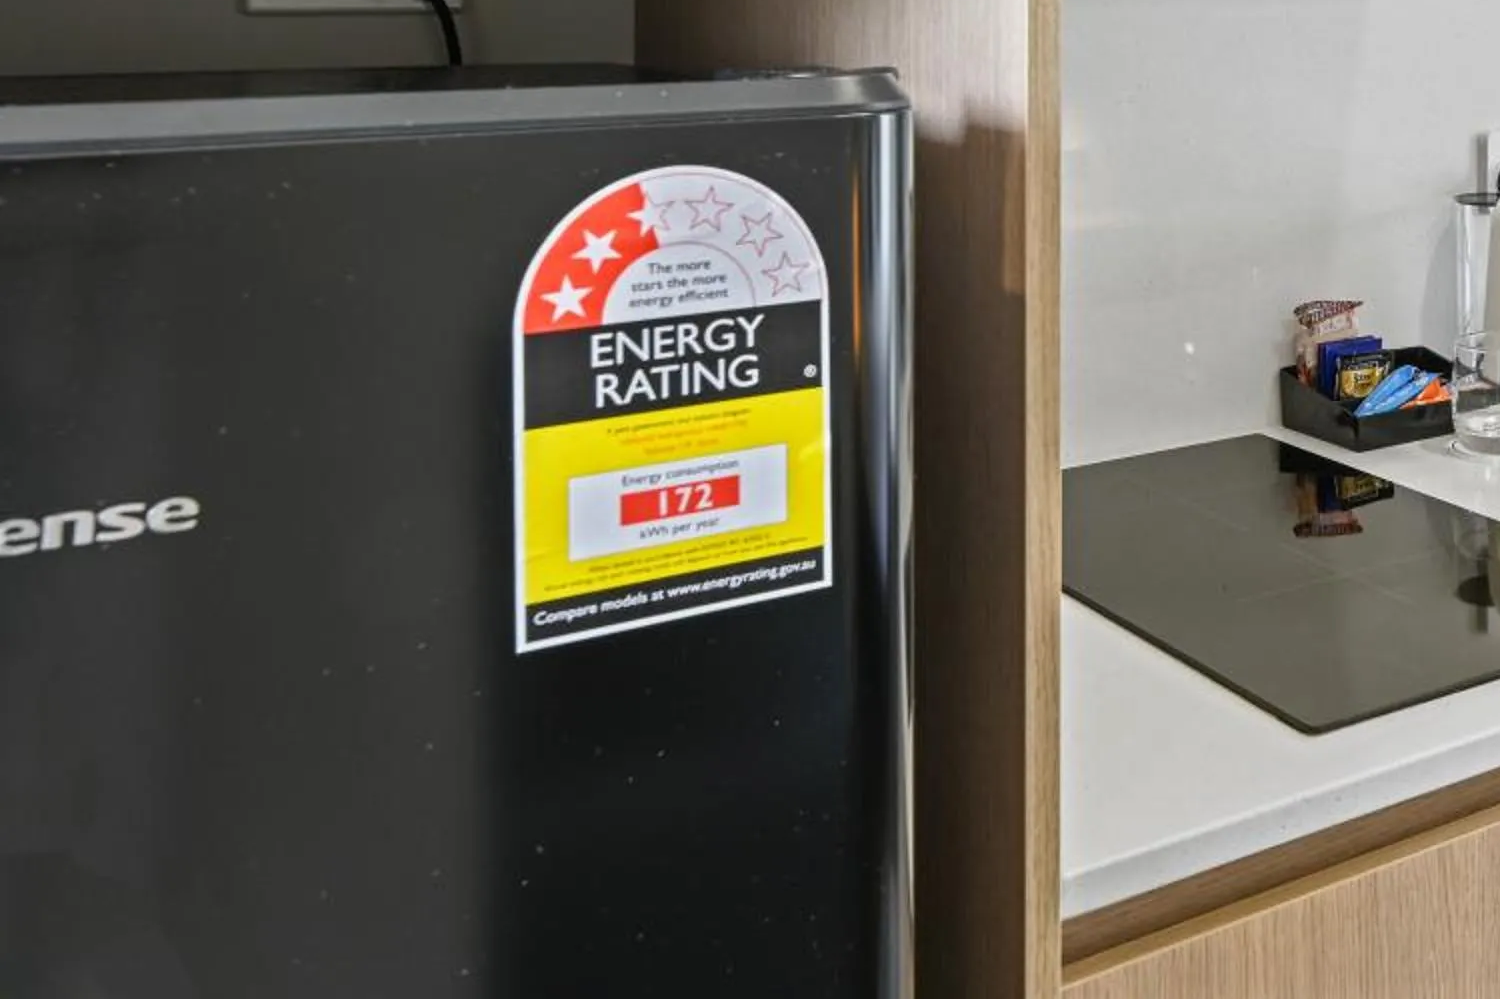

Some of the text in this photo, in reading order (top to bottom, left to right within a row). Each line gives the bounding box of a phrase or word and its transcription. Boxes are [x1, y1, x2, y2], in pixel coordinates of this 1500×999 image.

[648, 260, 711, 275] The more
[629, 287, 729, 309] energy efficient
[631, 274, 727, 293] stars the more
[590, 313, 764, 368] ENERGY
[595, 354, 760, 408] RATING
[621, 459, 740, 487] Energy consumption
[658, 484, 714, 516] 172
[0, 496, 200, 558] ense
[639, 517, 720, 540] kWh per year
[533, 603, 598, 626] Compare
[600, 591, 648, 613] models
[650, 587, 665, 601] at
[667, 559, 817, 598] www.energyrating.gov.au
